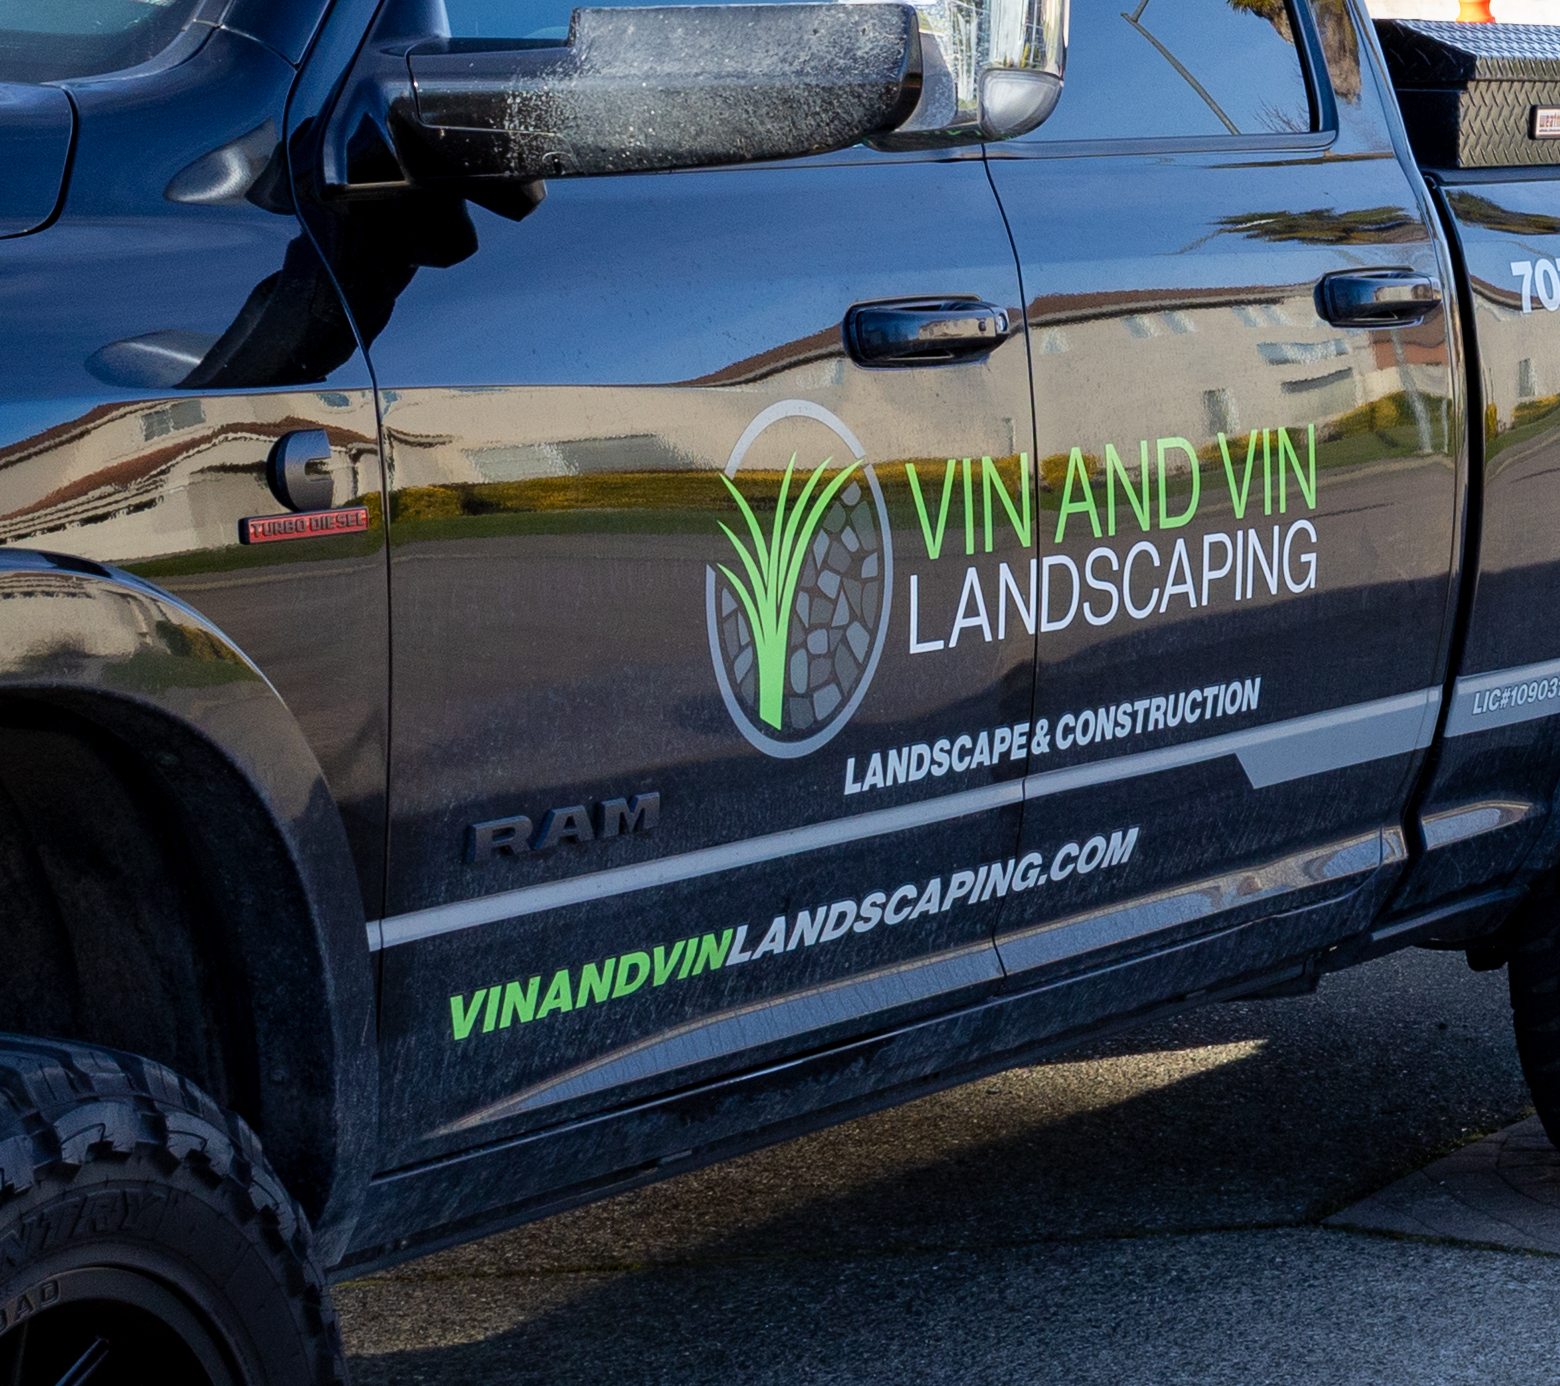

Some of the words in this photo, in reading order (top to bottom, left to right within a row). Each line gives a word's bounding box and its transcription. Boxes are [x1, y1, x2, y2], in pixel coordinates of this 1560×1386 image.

[250, 517, 308, 539] TURBO
[309, 511, 366, 531] DIESEL
[904, 451, 1032, 560] VIN
[1053, 435, 1201, 544] AND
[1216, 423, 1317, 520] VIN
[909, 519, 1318, 654] LANDSCAPING
[843, 721, 1031, 796] LANDSCAPE
[1031, 718, 1051, 755] &
[1054, 676, 1262, 751] CONSTRUCTION
[461, 791, 661, 865] RAM
[448, 827, 1140, 1041] VINANDVINLANDSCAPING.COM
